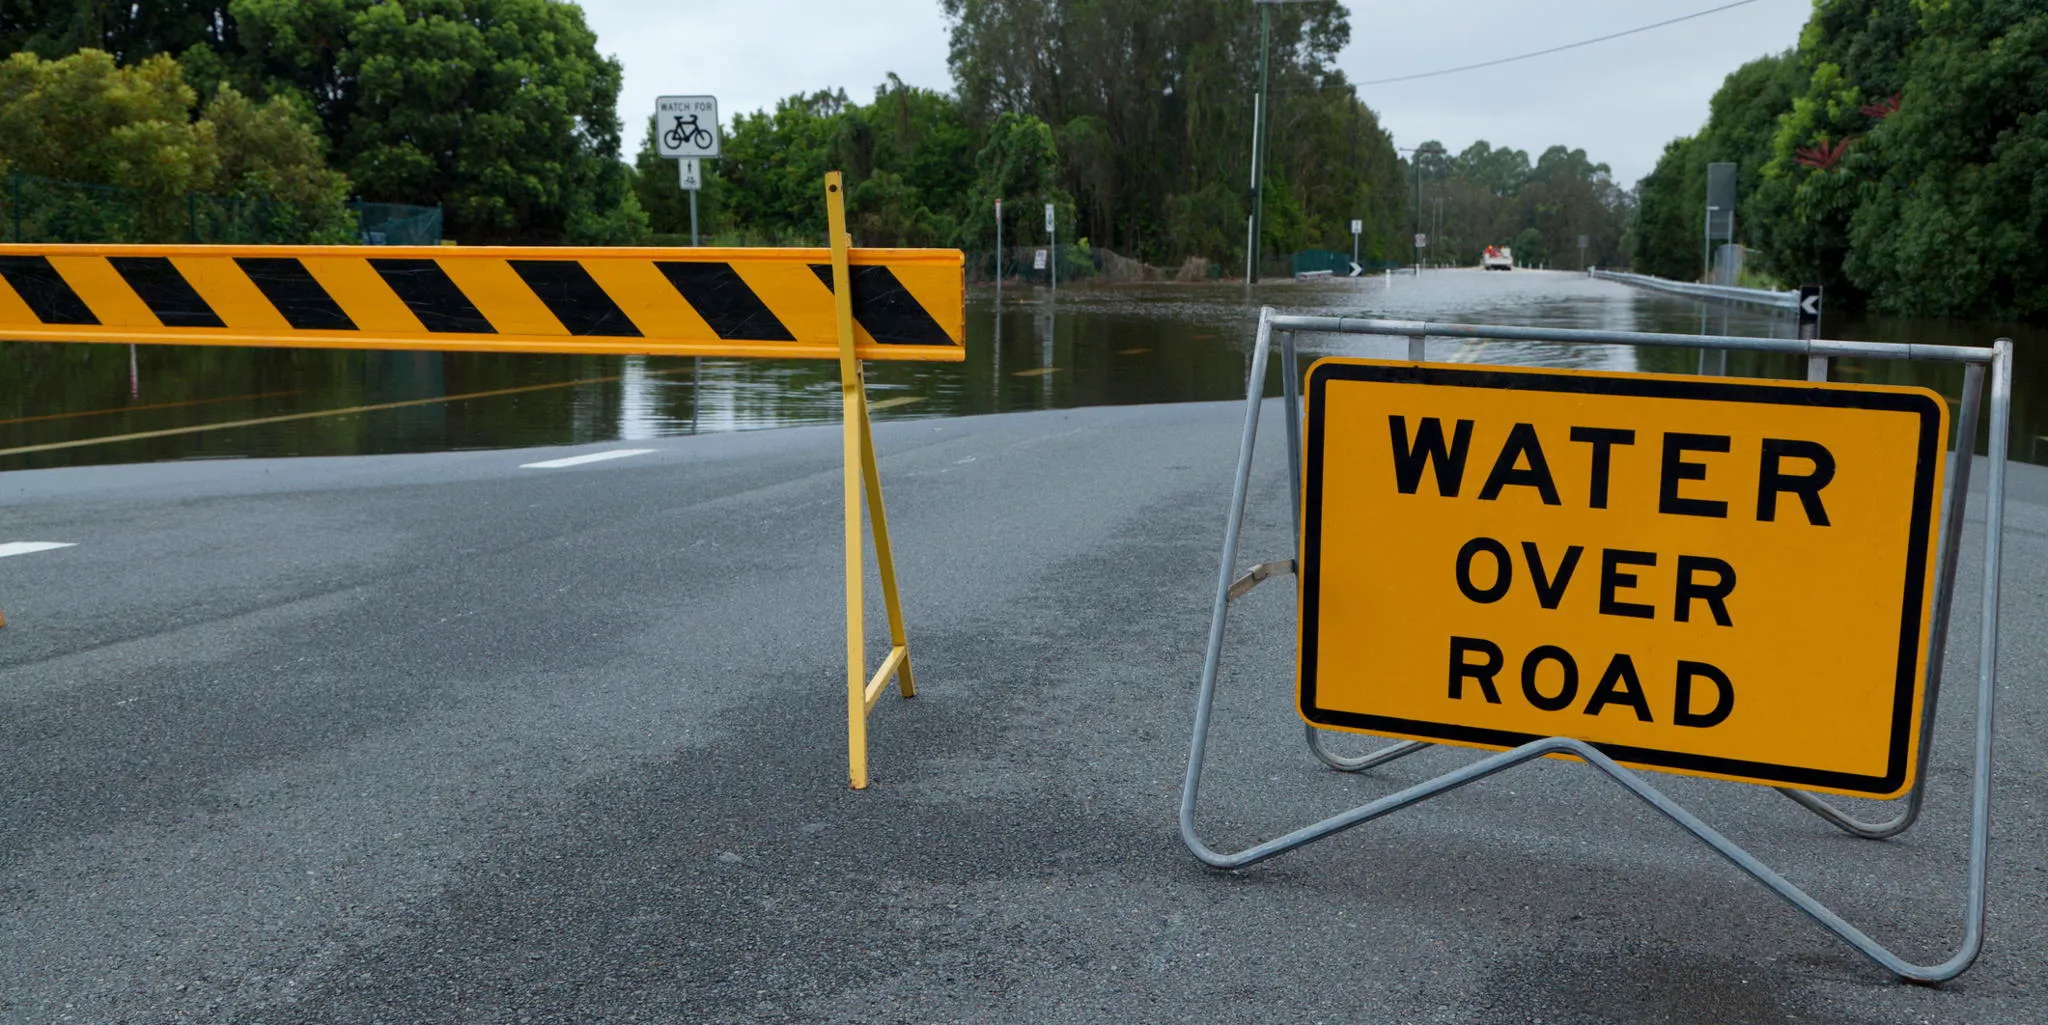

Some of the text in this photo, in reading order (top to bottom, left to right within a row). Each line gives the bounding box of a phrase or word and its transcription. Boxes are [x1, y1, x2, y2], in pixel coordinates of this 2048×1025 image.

[661, 102, 713, 112] WATCH FOR
[1389, 415, 1836, 527] WATER
[1456, 537, 1737, 628] OVER
[1448, 636, 1735, 729] ROAD
